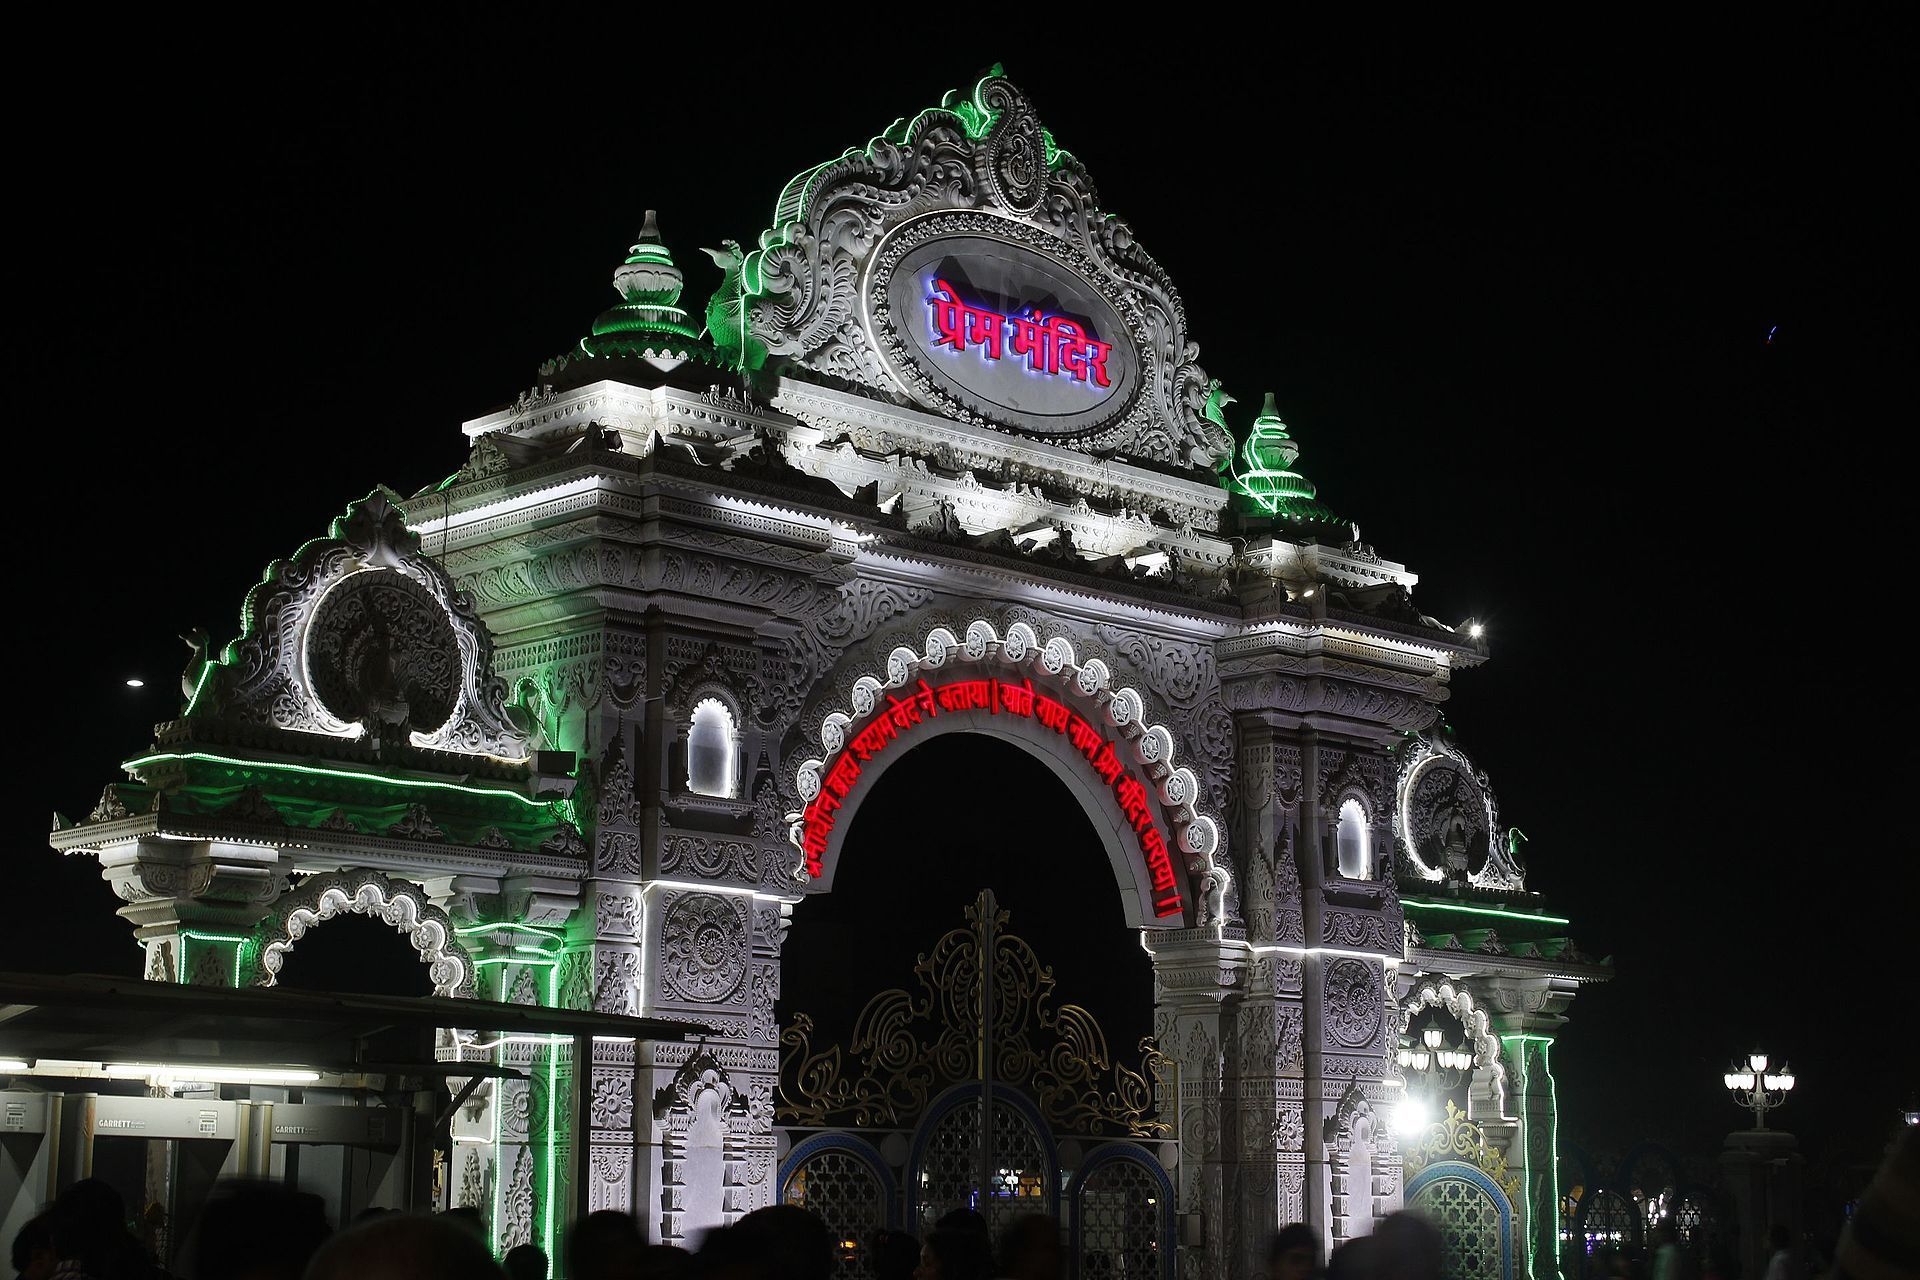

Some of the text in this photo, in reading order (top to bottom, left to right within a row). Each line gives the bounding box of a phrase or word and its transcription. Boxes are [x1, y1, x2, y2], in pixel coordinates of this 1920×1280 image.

[927, 279, 1112, 388] प्रेम मंदिर
[849, 712, 897, 760] श्याम
[885, 694, 923, 729] वेद
[916, 678, 937, 717] ने
[999, 677, 1036, 718] याते
[1070, 716, 1104, 762] नाम
[1094, 741, 1126, 786] प्रेम
[1118, 775, 1153, 831] मंदिर
[98, 1119, 131, 1129] GARRETT
[275, 1126, 305, 1135] GARRETT
